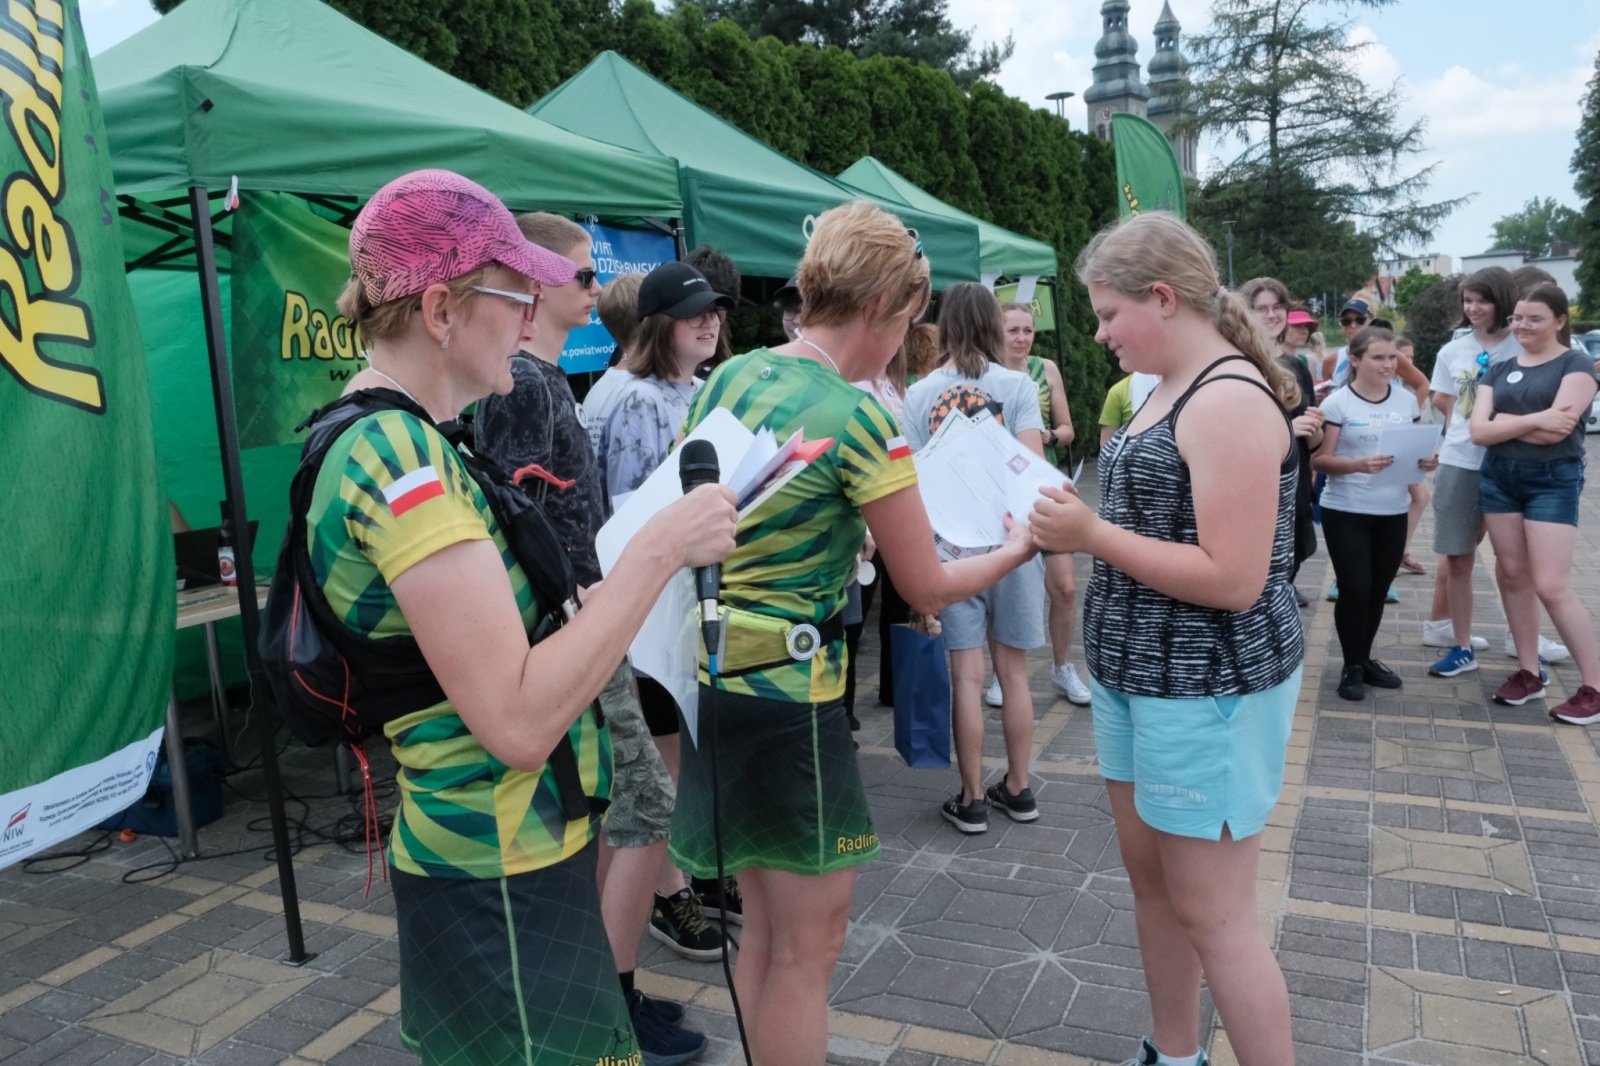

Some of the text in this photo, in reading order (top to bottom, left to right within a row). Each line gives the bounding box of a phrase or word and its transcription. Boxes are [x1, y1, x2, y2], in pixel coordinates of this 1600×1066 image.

[589, 241, 613, 256] WIAT
[559, 342, 617, 360] w.powiatwod
[3, 824, 25, 843] NIW
